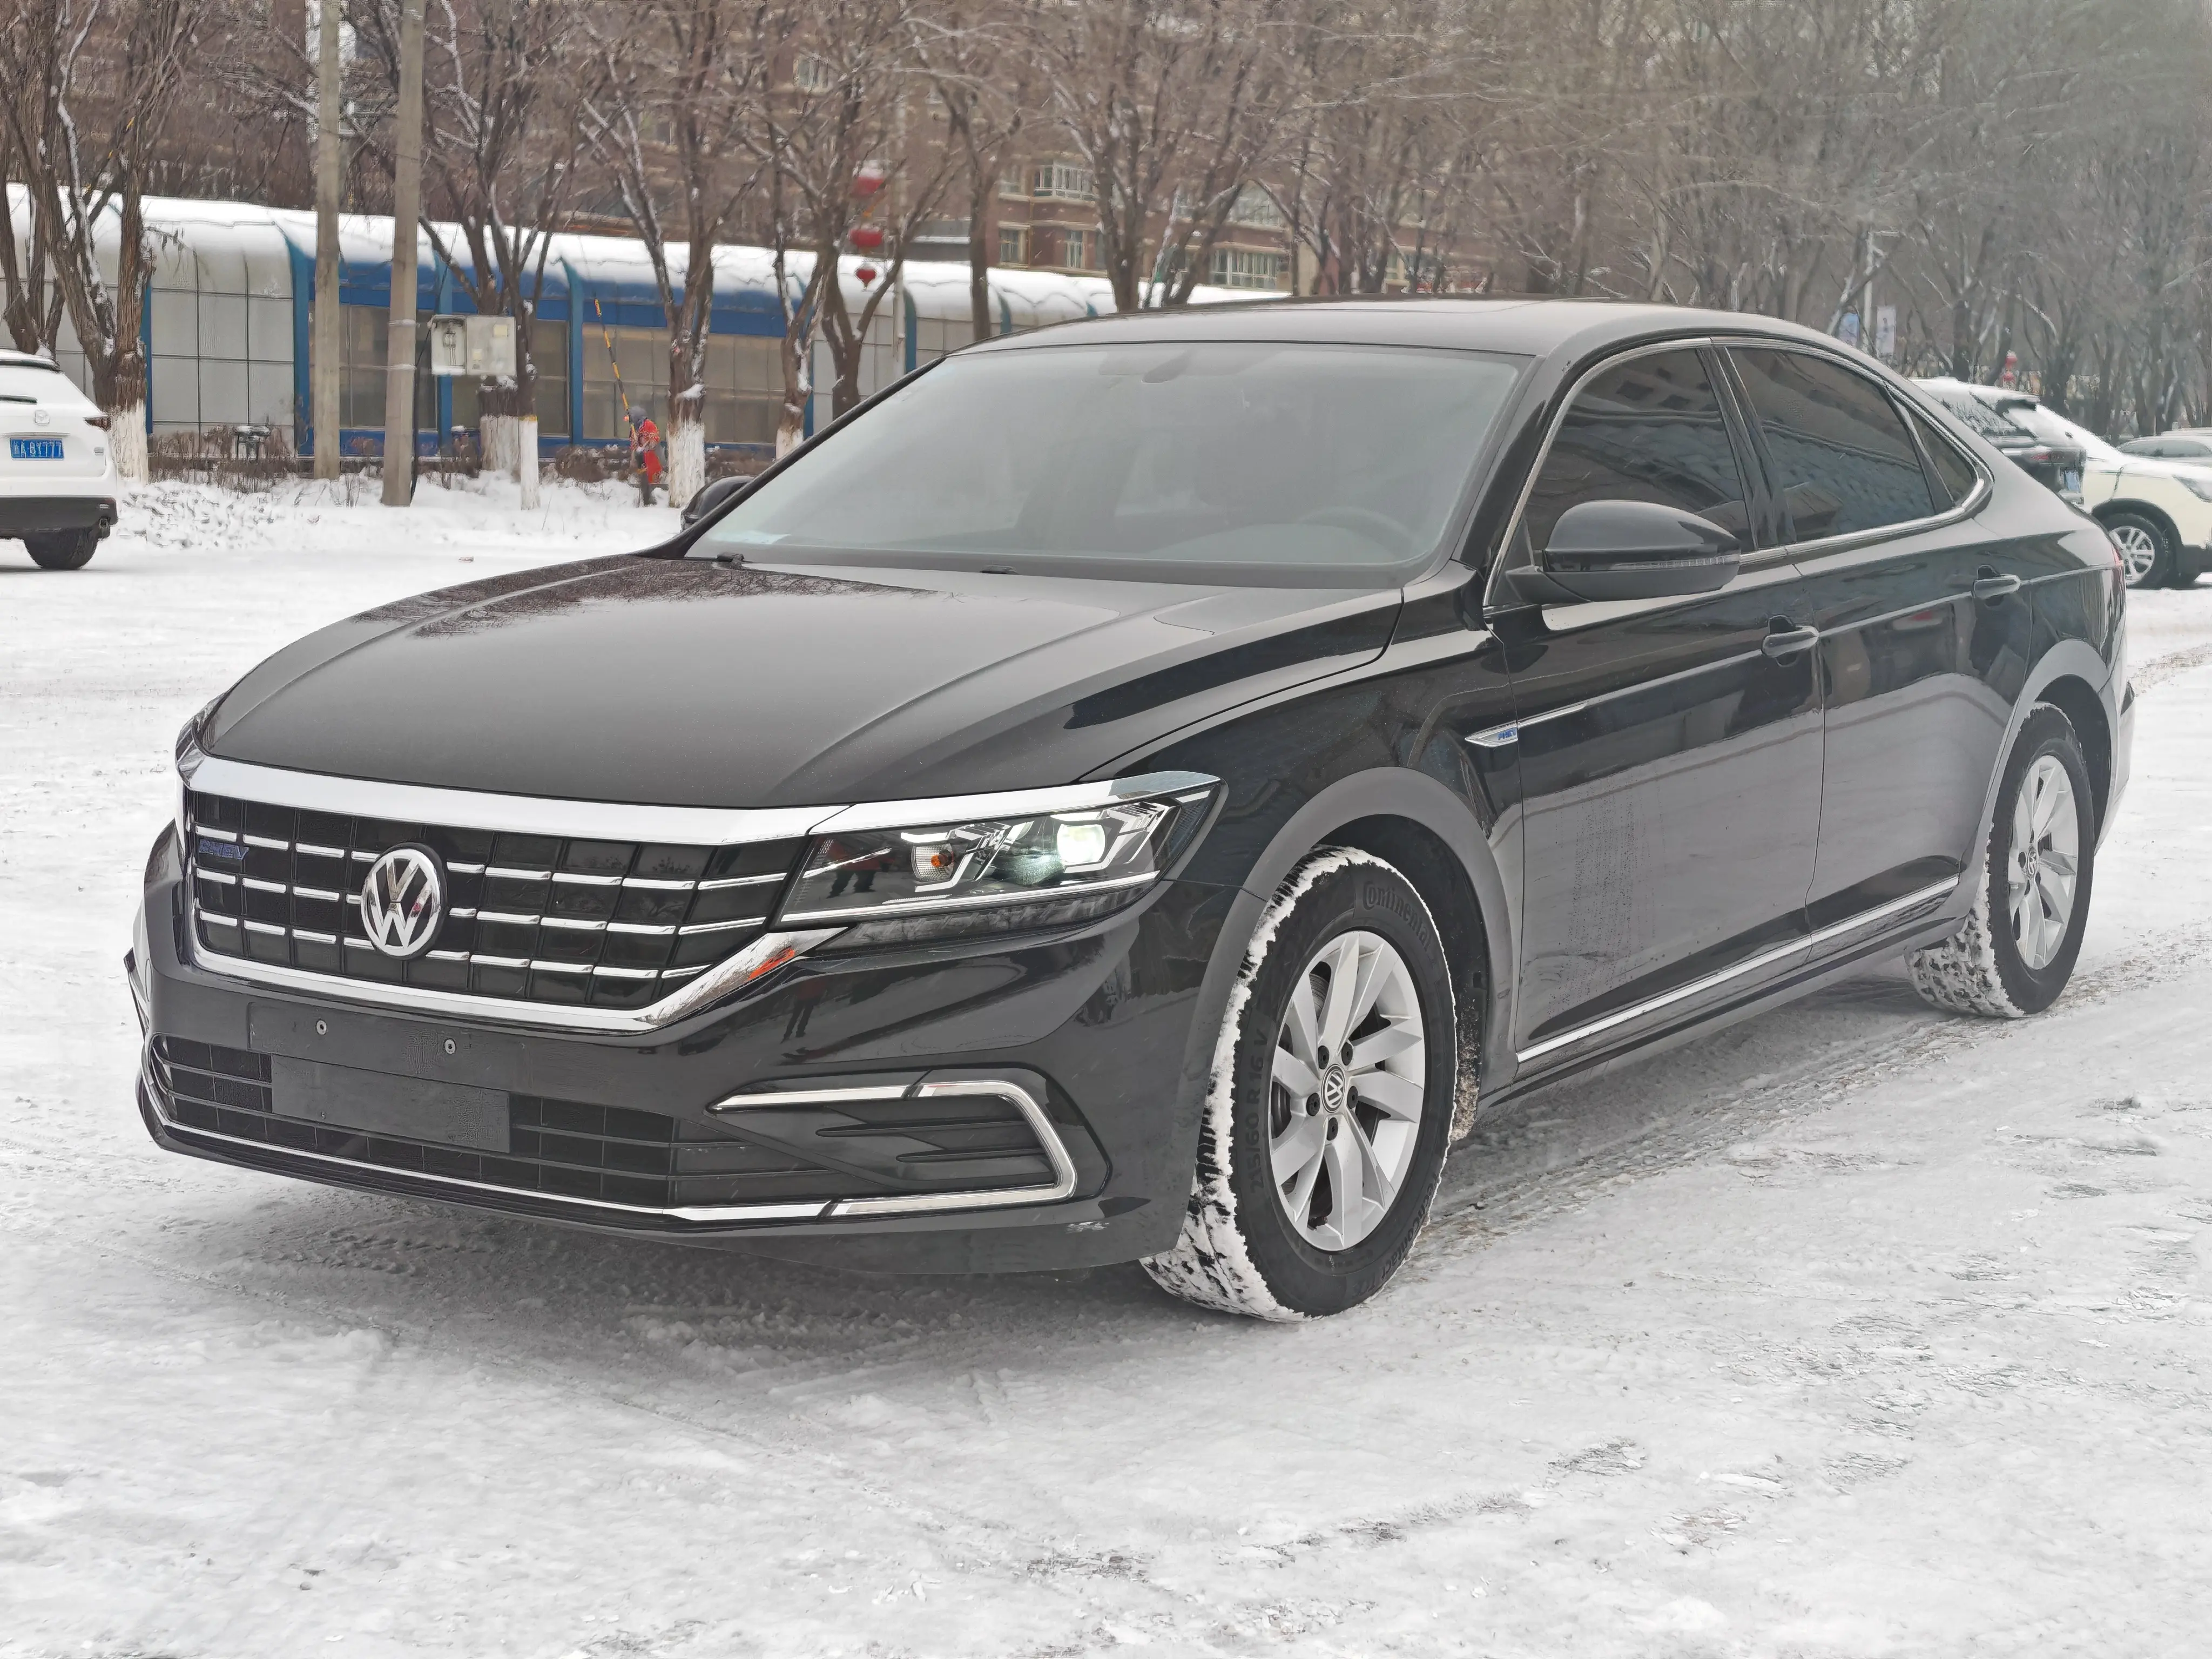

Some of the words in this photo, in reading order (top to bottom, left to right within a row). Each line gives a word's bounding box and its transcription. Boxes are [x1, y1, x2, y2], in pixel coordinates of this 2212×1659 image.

[362, 849, 440, 956] VW
[1363, 880, 1430, 952] Continental
[1254, 1029, 1268, 1047] V
[1248, 1055, 1264, 1081] 16
[1247, 1088, 1261, 1104] R
[1325, 1069, 1345, 1108] VW
[1245, 1112, 1264, 1193] 215/60
